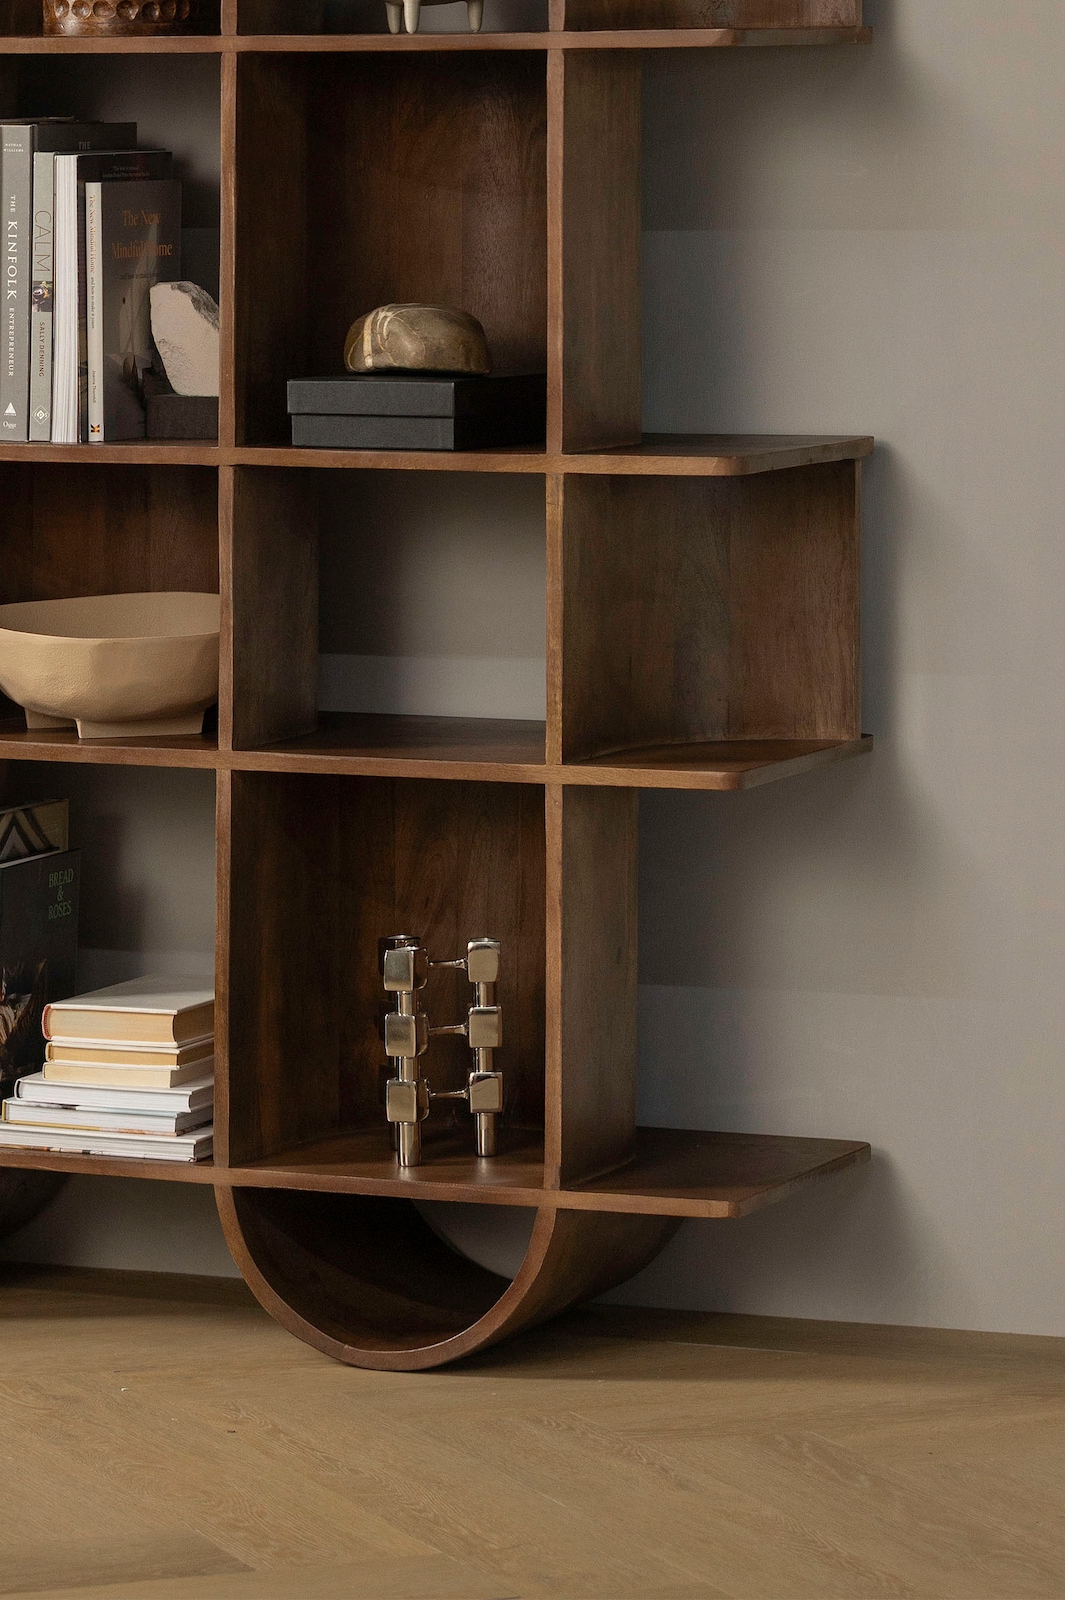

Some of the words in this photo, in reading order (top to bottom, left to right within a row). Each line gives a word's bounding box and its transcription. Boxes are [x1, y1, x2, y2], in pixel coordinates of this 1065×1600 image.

[121, 209, 138, 226] The
[140, 208, 162, 225] New
[34, 210, 52, 272] CALM
[7, 221, 17, 300] KINFOLK
[48, 868, 74, 888] BREAD
[57, 885, 64, 901] &
[48, 901, 72, 920] ROSES
